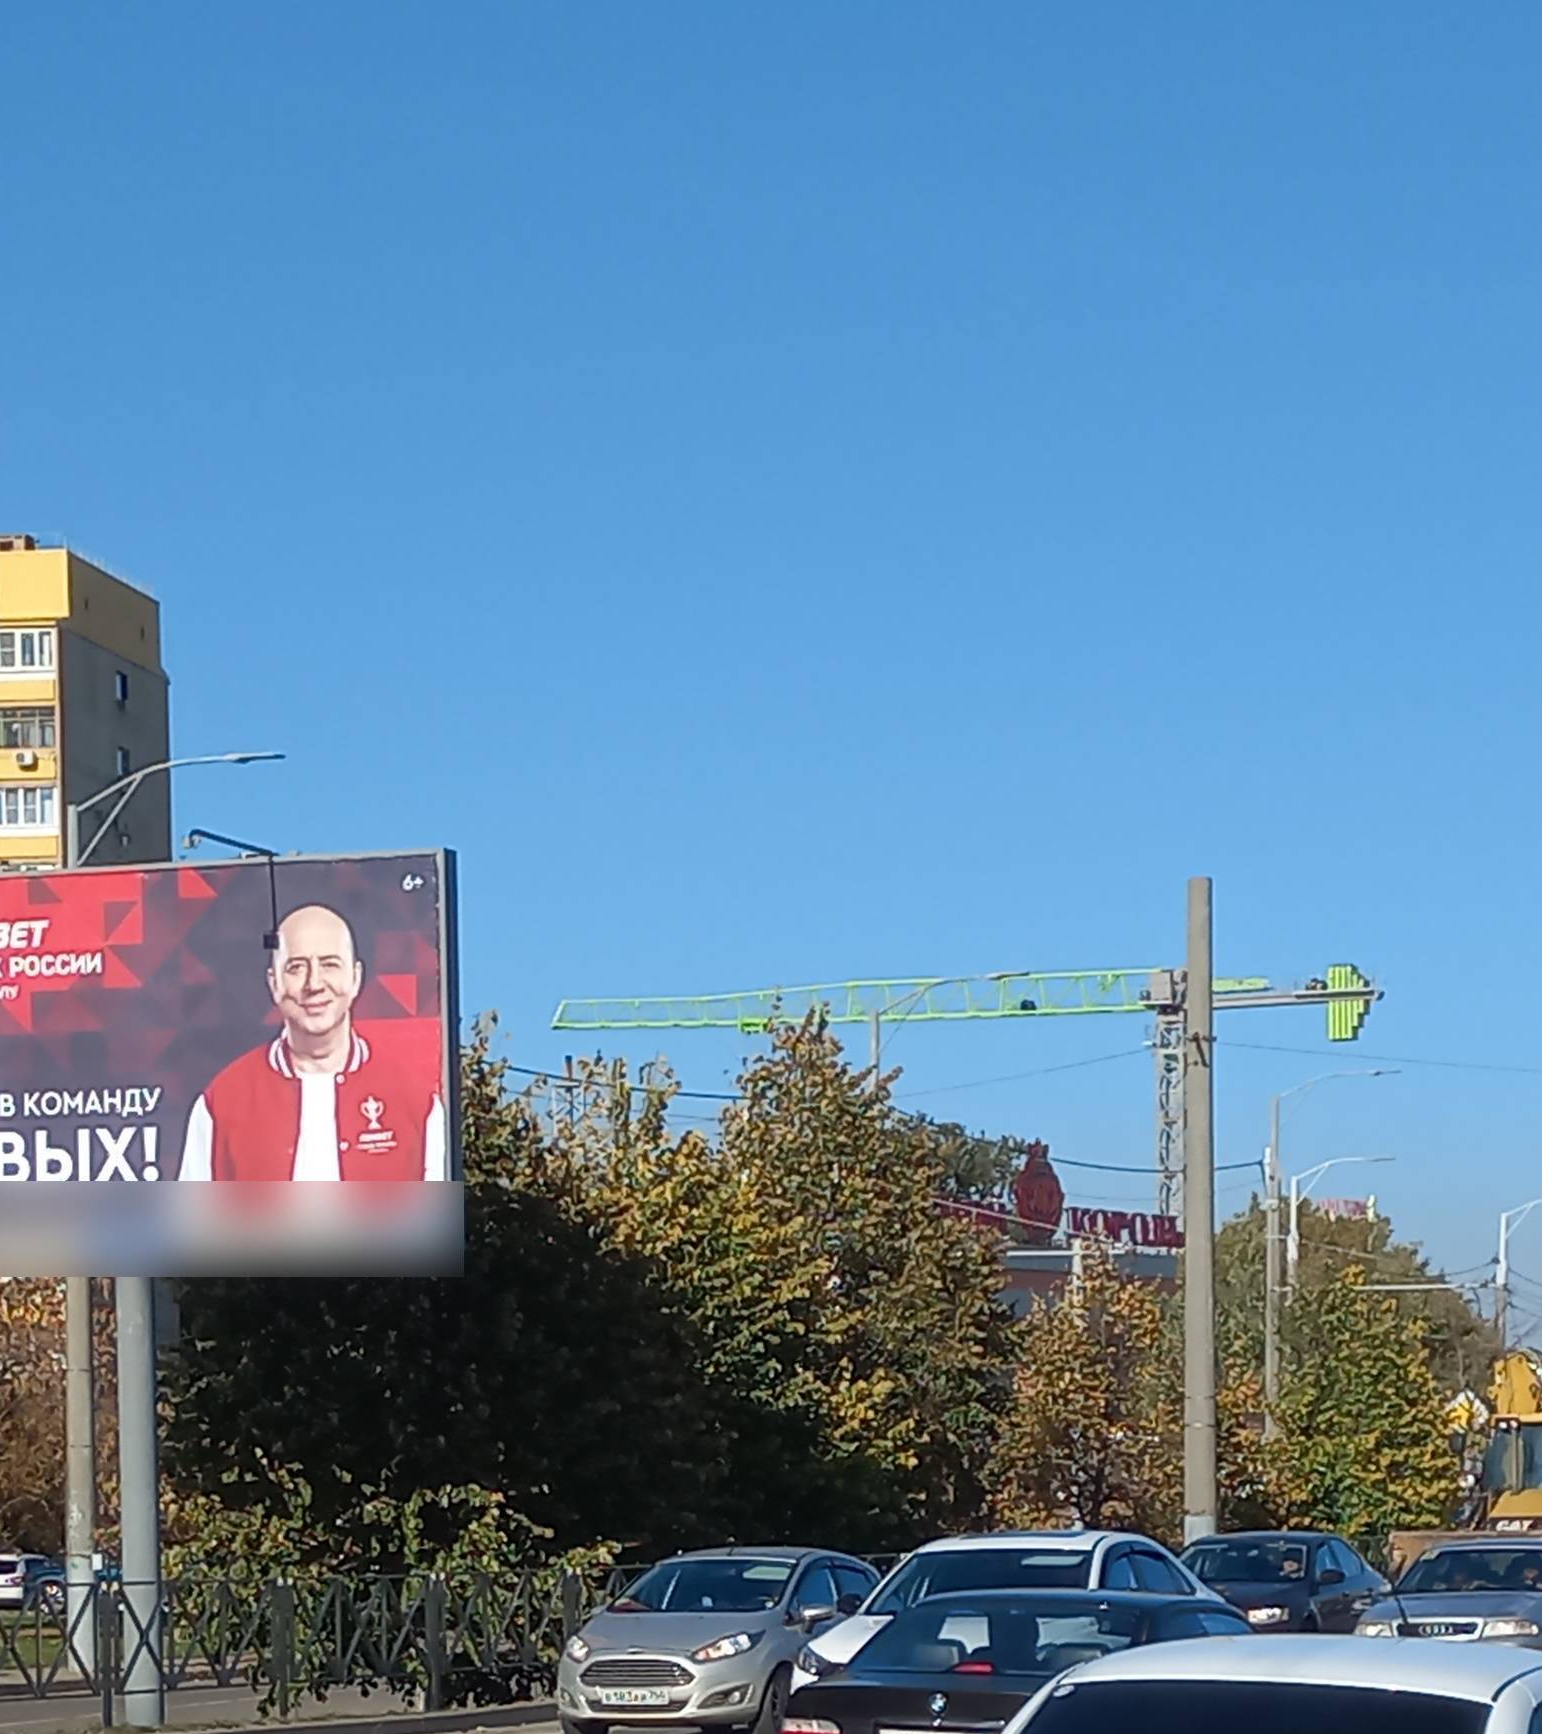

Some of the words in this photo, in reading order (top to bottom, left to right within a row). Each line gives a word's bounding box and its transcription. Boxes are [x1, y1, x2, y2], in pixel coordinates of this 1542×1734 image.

[402, 873, 424, 891] 6+
[9, 952, 103, 978] РОССИИ
[0, 1094, 16, 1118] В
[23, 1088, 162, 1117] КОМАНДУ
